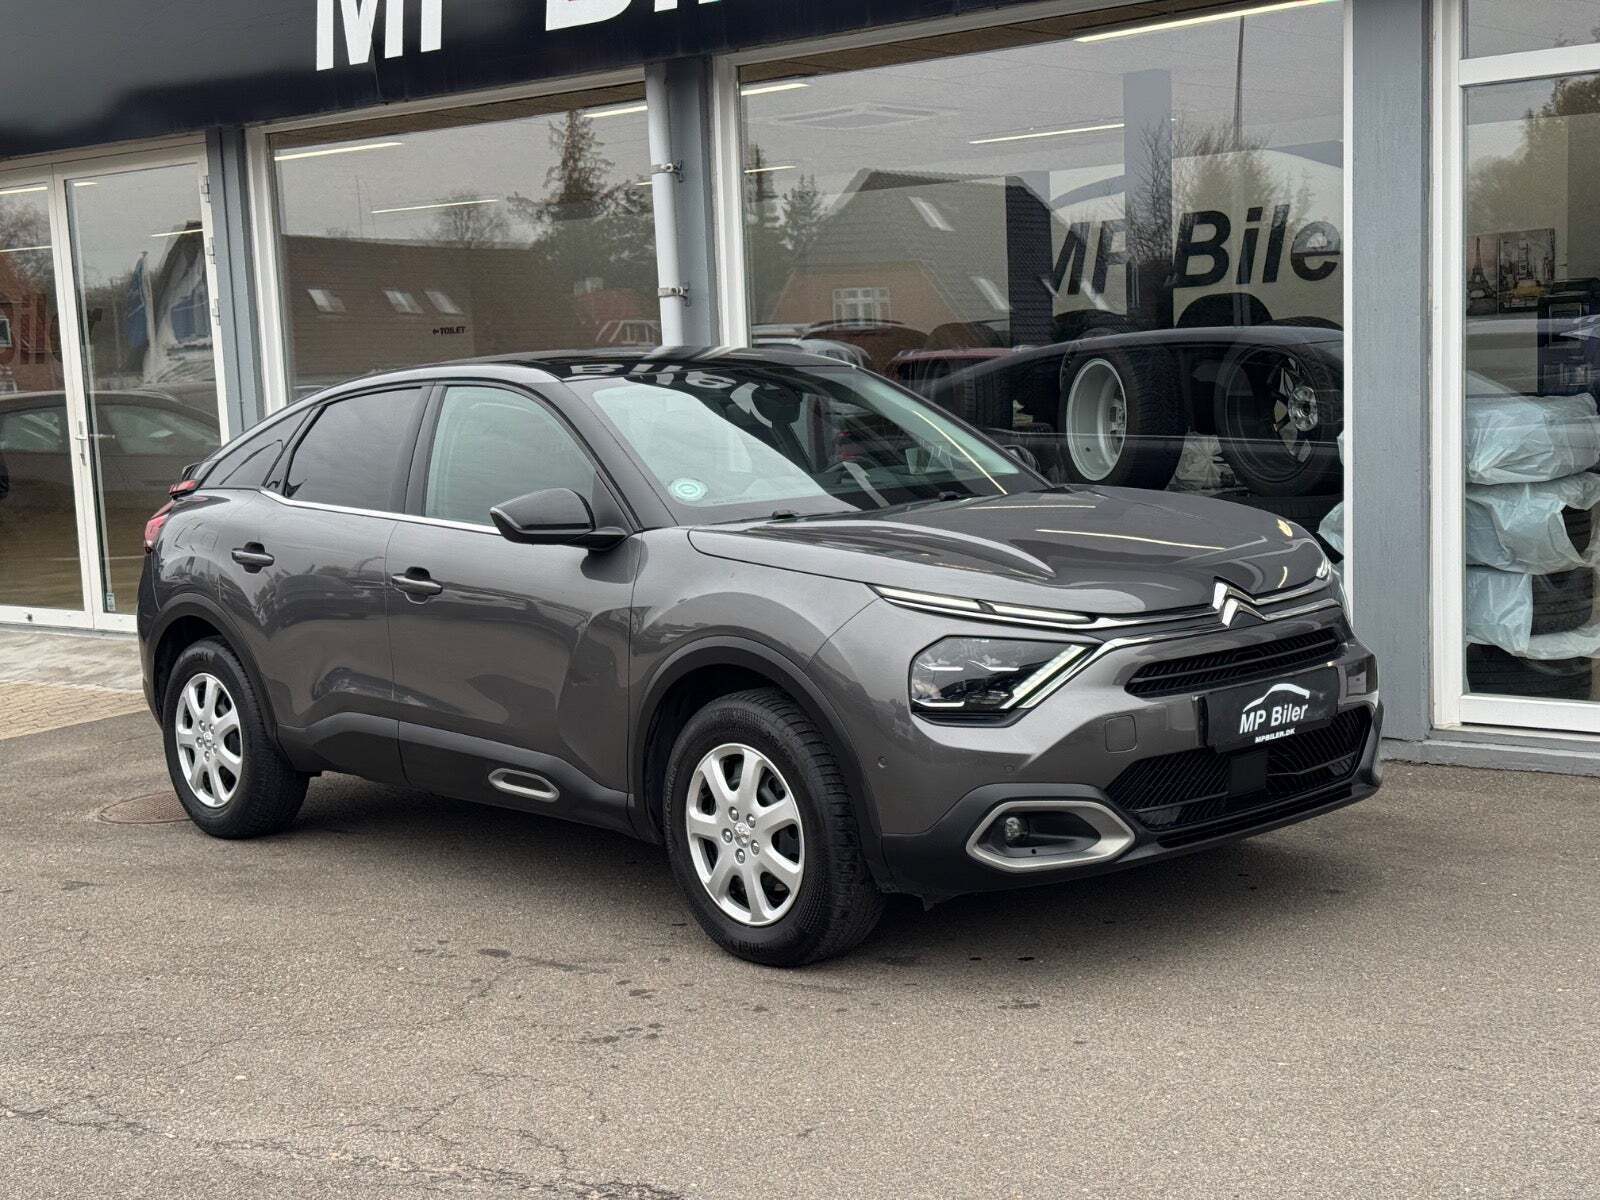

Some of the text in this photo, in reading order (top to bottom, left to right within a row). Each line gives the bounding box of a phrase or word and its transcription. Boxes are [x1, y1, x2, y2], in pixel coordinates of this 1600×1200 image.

[1240, 704, 1308, 734] MP Biler
[1254, 728, 1295, 743] MPBILER.DK
